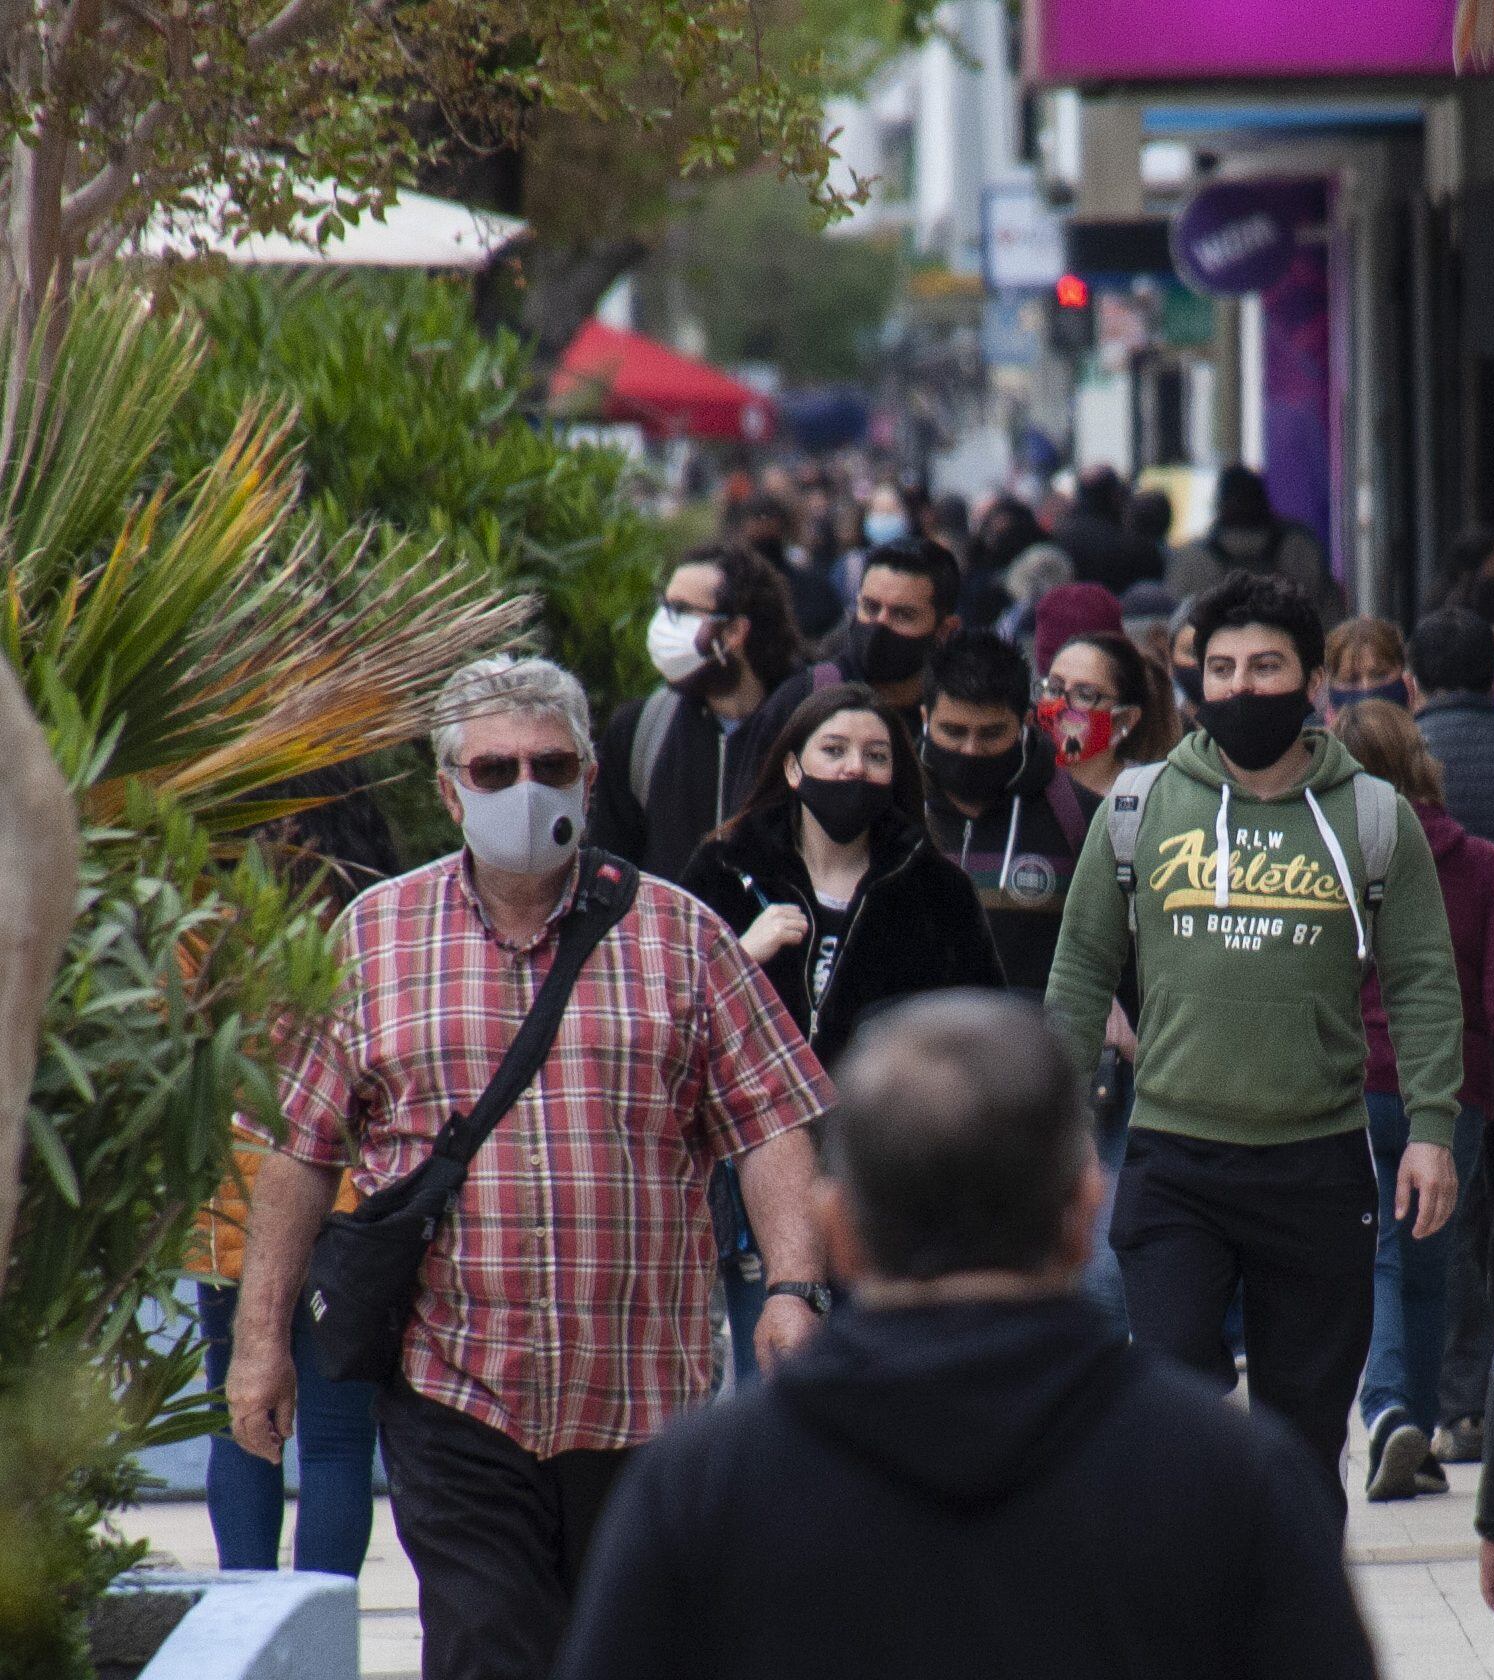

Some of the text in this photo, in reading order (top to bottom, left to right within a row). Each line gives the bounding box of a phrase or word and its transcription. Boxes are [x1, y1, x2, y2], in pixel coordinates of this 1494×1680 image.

[1172, 913, 1323, 946] 19 BOXING 87
[1224, 934, 1262, 951] YARD
